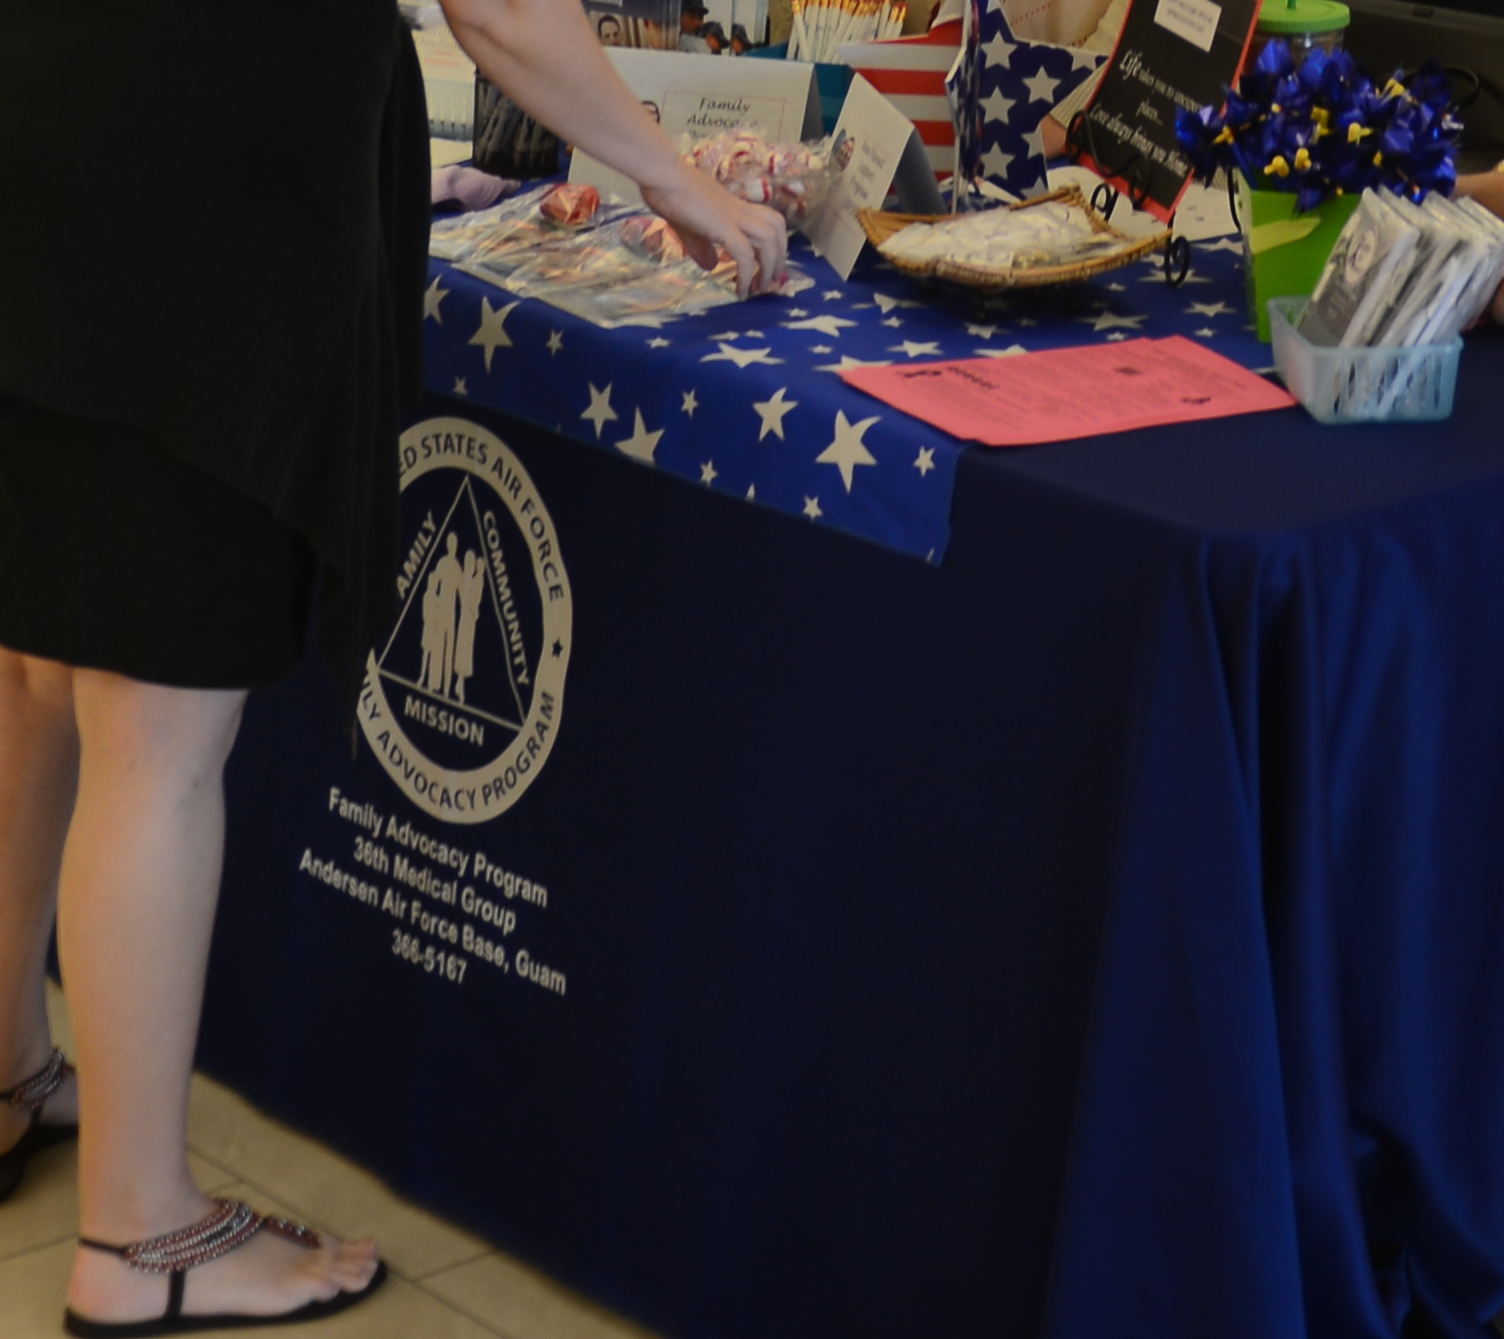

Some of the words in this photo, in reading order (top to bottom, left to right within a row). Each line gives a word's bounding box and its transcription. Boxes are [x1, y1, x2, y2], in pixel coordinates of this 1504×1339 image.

[698, 96, 752, 115] Family
[1119, 49, 1143, 81] Life
[687, 114, 758, 129] Advoc
[1106, 113, 1134, 144] always
[1130, 126, 1155, 157] brings
[396, 508, 437, 601] AMILY
[420, 432, 489, 466] STATES
[491, 455, 523, 501] AIR
[519, 497, 565, 603] FORCE
[483, 509, 530, 686] COMMUNITY
[376, 729, 478, 812] ADVOCACY
[481, 690, 555, 807] PROGRAM
[403, 694, 486, 748] MISSION
[328, 785, 384, 839] Family
[385, 814, 470, 878] Advocacy
[473, 852, 548, 909] Program
[353, 835, 390, 874] 36th
[393, 852, 458, 906] Medical
[461, 885, 517, 936] Group
[299, 846, 379, 908] Andersen
[381, 887, 408, 919] Air
[410, 898, 459, 945] Force
[461, 923, 511, 974] Base,
[514, 948, 567, 997] Guam
[391, 928, 468, 985] 366-5167
